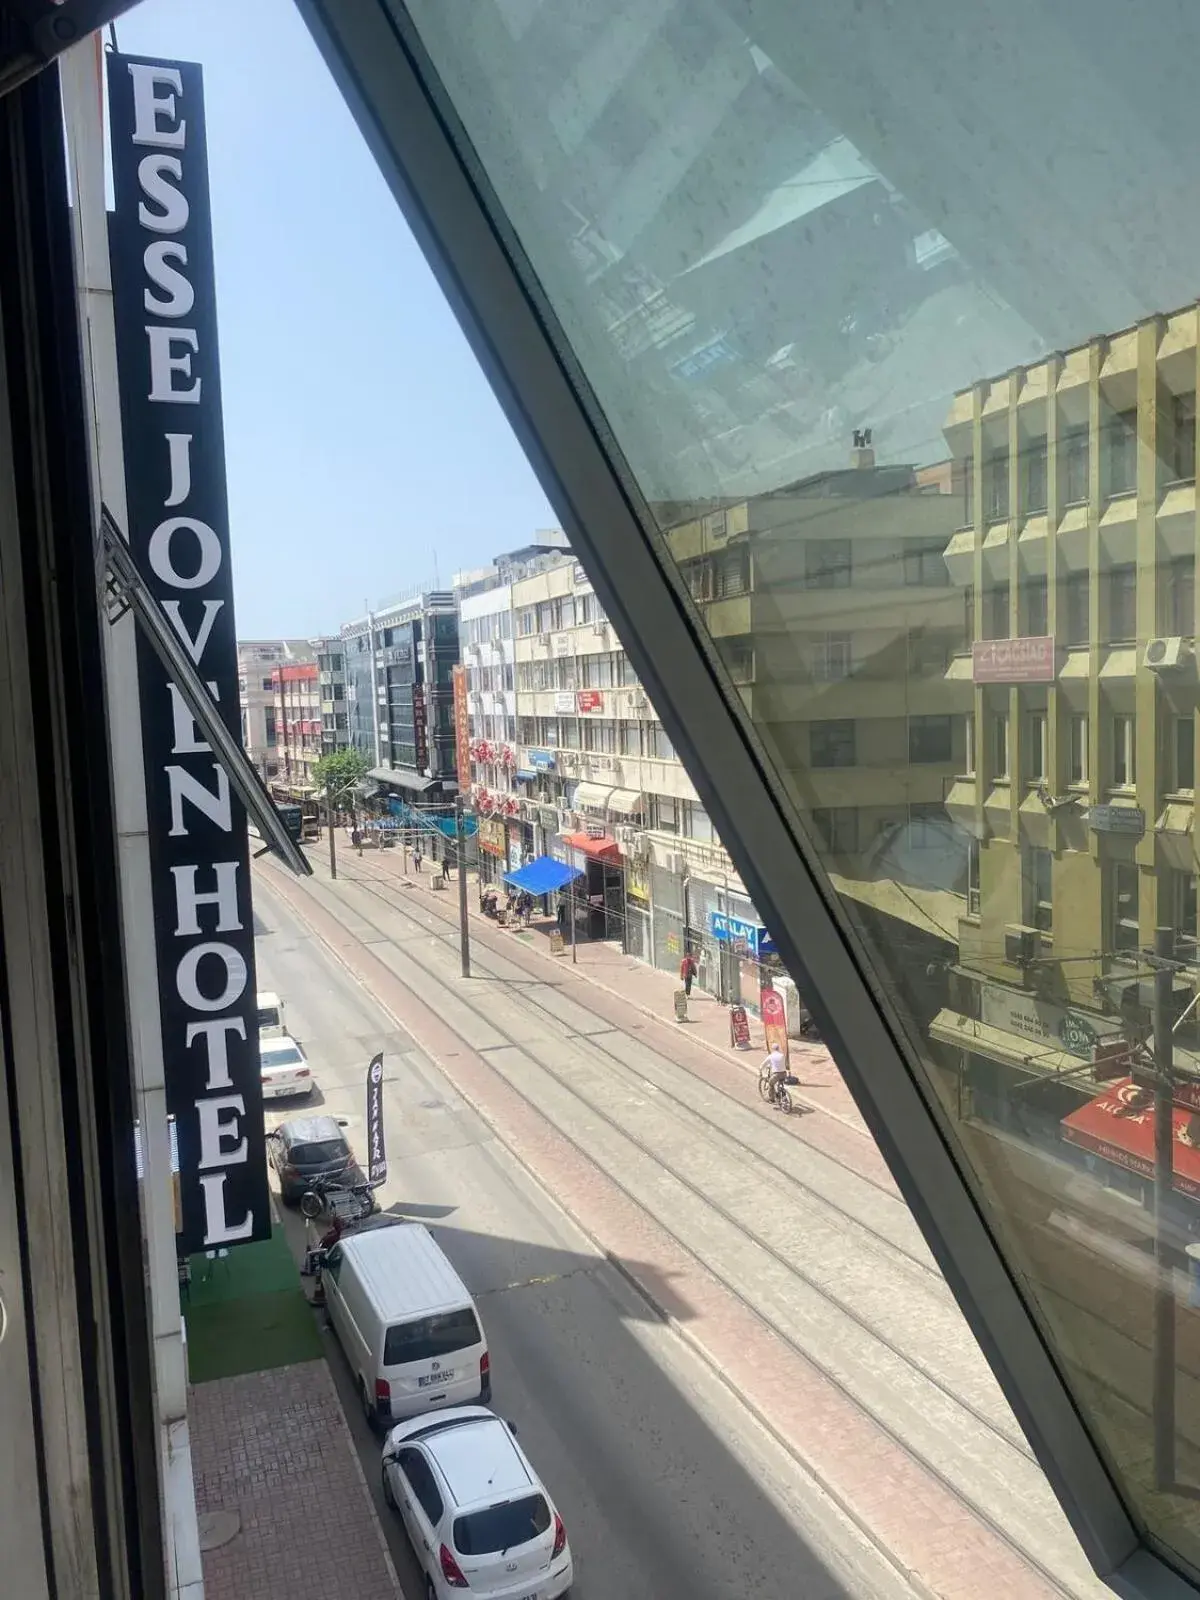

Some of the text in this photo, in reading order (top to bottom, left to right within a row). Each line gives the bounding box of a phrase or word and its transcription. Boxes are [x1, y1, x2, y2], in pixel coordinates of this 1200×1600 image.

[127, 63, 253, 1245] ESSE JOVEN HOTEL
